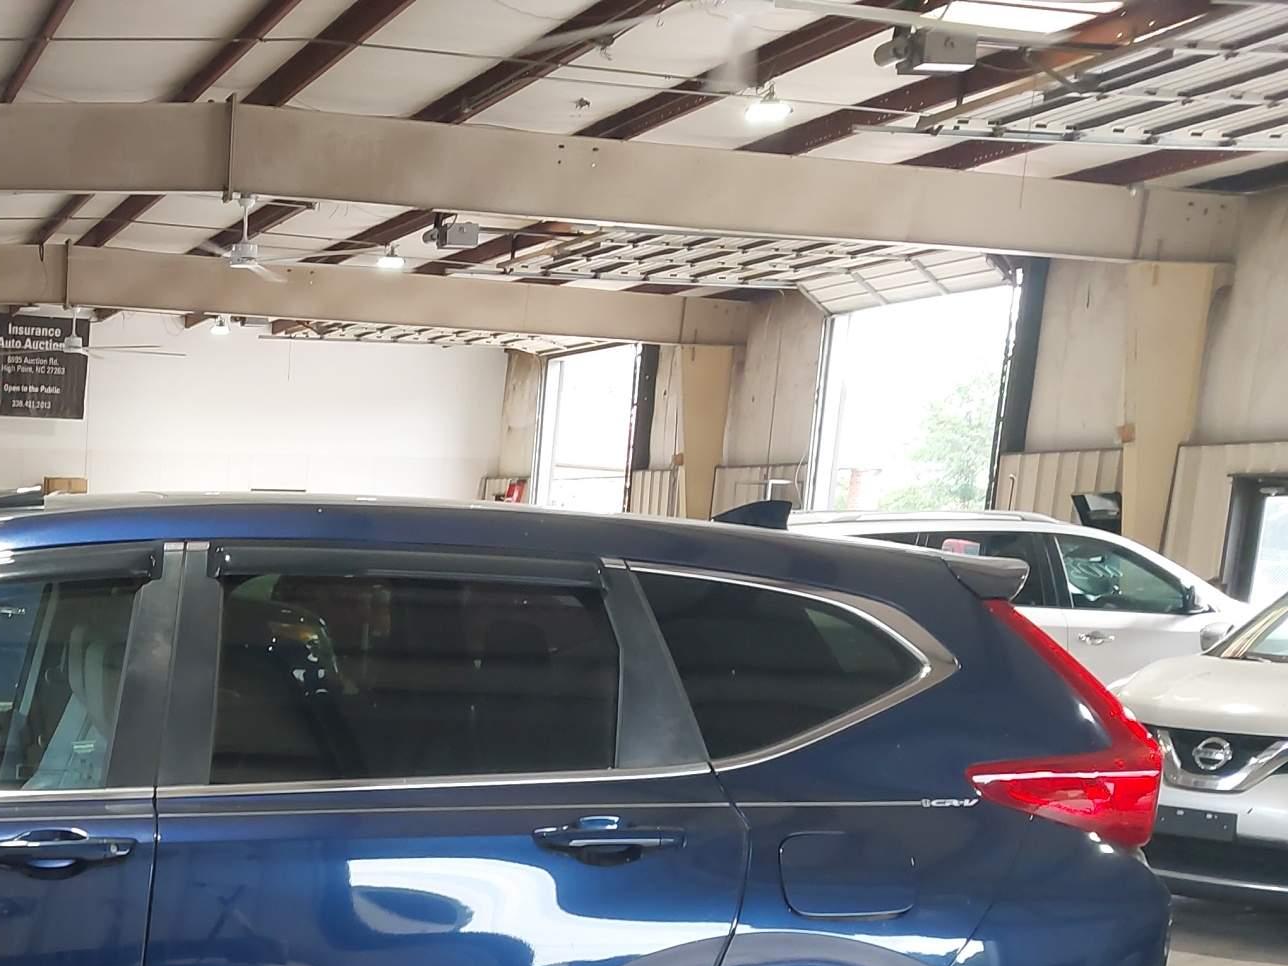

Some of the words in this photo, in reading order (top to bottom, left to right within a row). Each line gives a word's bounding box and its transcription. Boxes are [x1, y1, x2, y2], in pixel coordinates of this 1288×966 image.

[8, 322, 61, 337] Insurance
[23, 337, 66, 352] Auction
[24, 356, 48, 366] Auction
[35, 365, 46, 374] NC
[4, 383, 20, 393] Open
[28, 385, 39, 393] the
[40, 385, 61, 394] Public
